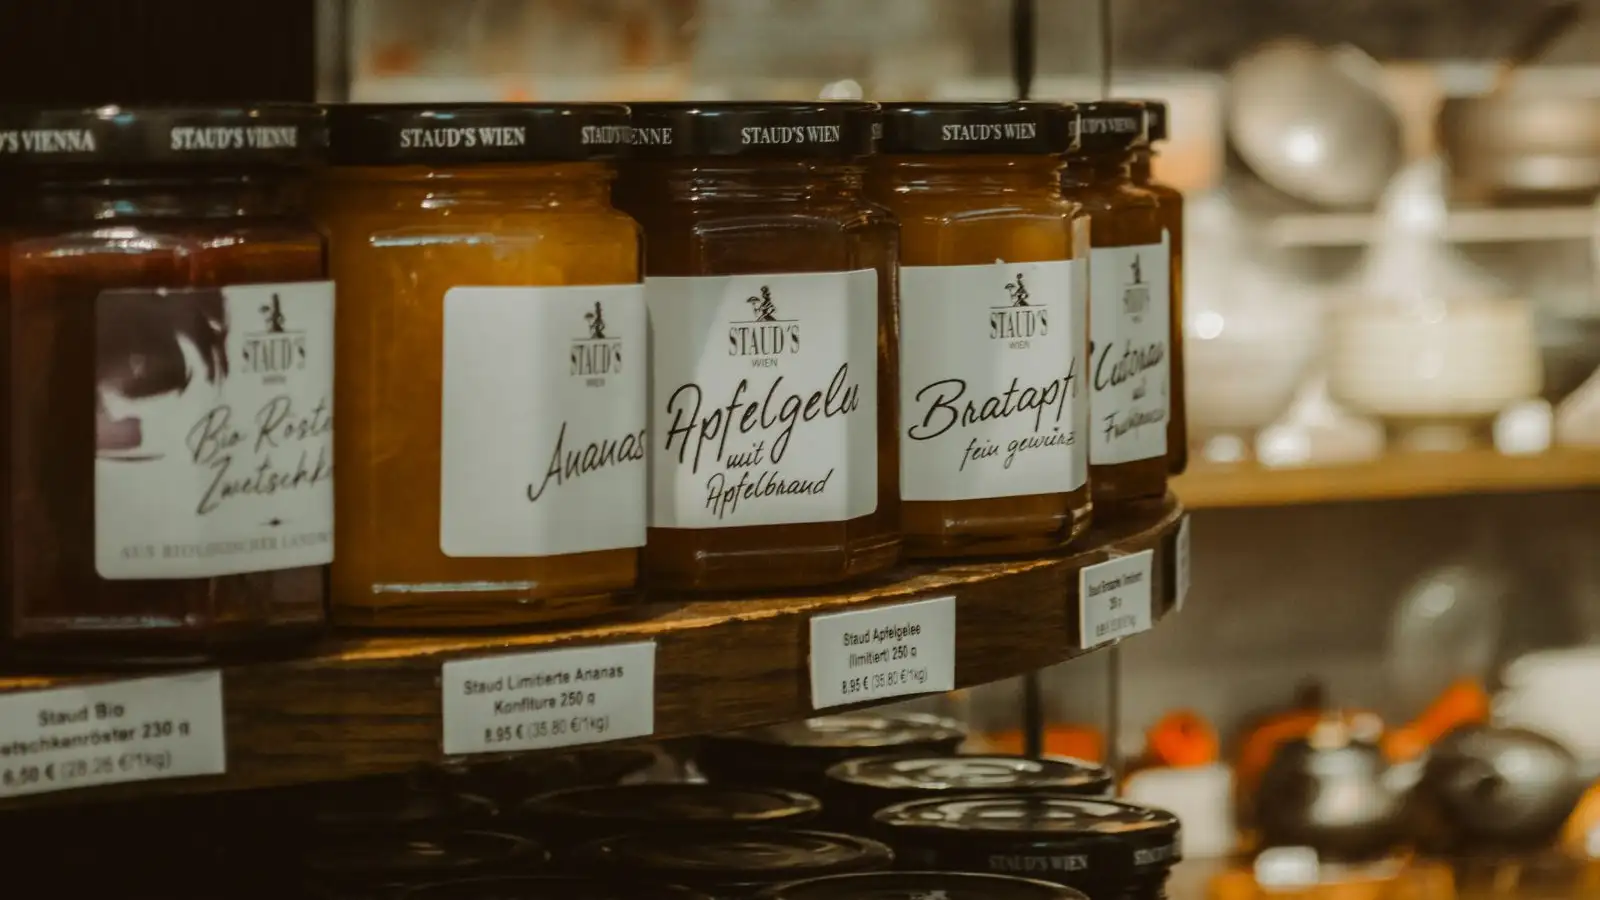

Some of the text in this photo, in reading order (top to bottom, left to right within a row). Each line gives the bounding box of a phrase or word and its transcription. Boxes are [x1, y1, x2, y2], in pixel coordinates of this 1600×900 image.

[21, 129, 96, 152] VIENNA
[170, 127, 244, 149] STAUD'S
[400, 126, 526, 148] STAUD'S WIEN
[741, 125, 841, 145] STAUD'S WIEN
[942, 122, 1036, 141] STAUD'S WIEN
[989, 308, 1049, 340] STAUD'S
[728, 324, 800, 356] STAUD'S
[242, 337, 306, 374] STAUD'S
[570, 342, 622, 376] STAUD'S
[751, 358, 779, 368] WIEN
[526, 421, 647, 502] Ananas
[726, 440, 765, 470] mit
[958, 437, 1000, 472] fein
[704, 468, 836, 520] Apfelbrand
[843, 622, 922, 646] Staud Apfelgelee
[892, 644, 908, 660] 250
[463, 664, 624, 696] Staud Limitierte Ananas
[863, 676, 869, 690] €
[560, 690, 584, 707] 250
[38, 702, 125, 728] Staud Bio
[142, 720, 173, 739] 230
[515, 723, 524, 740] €
